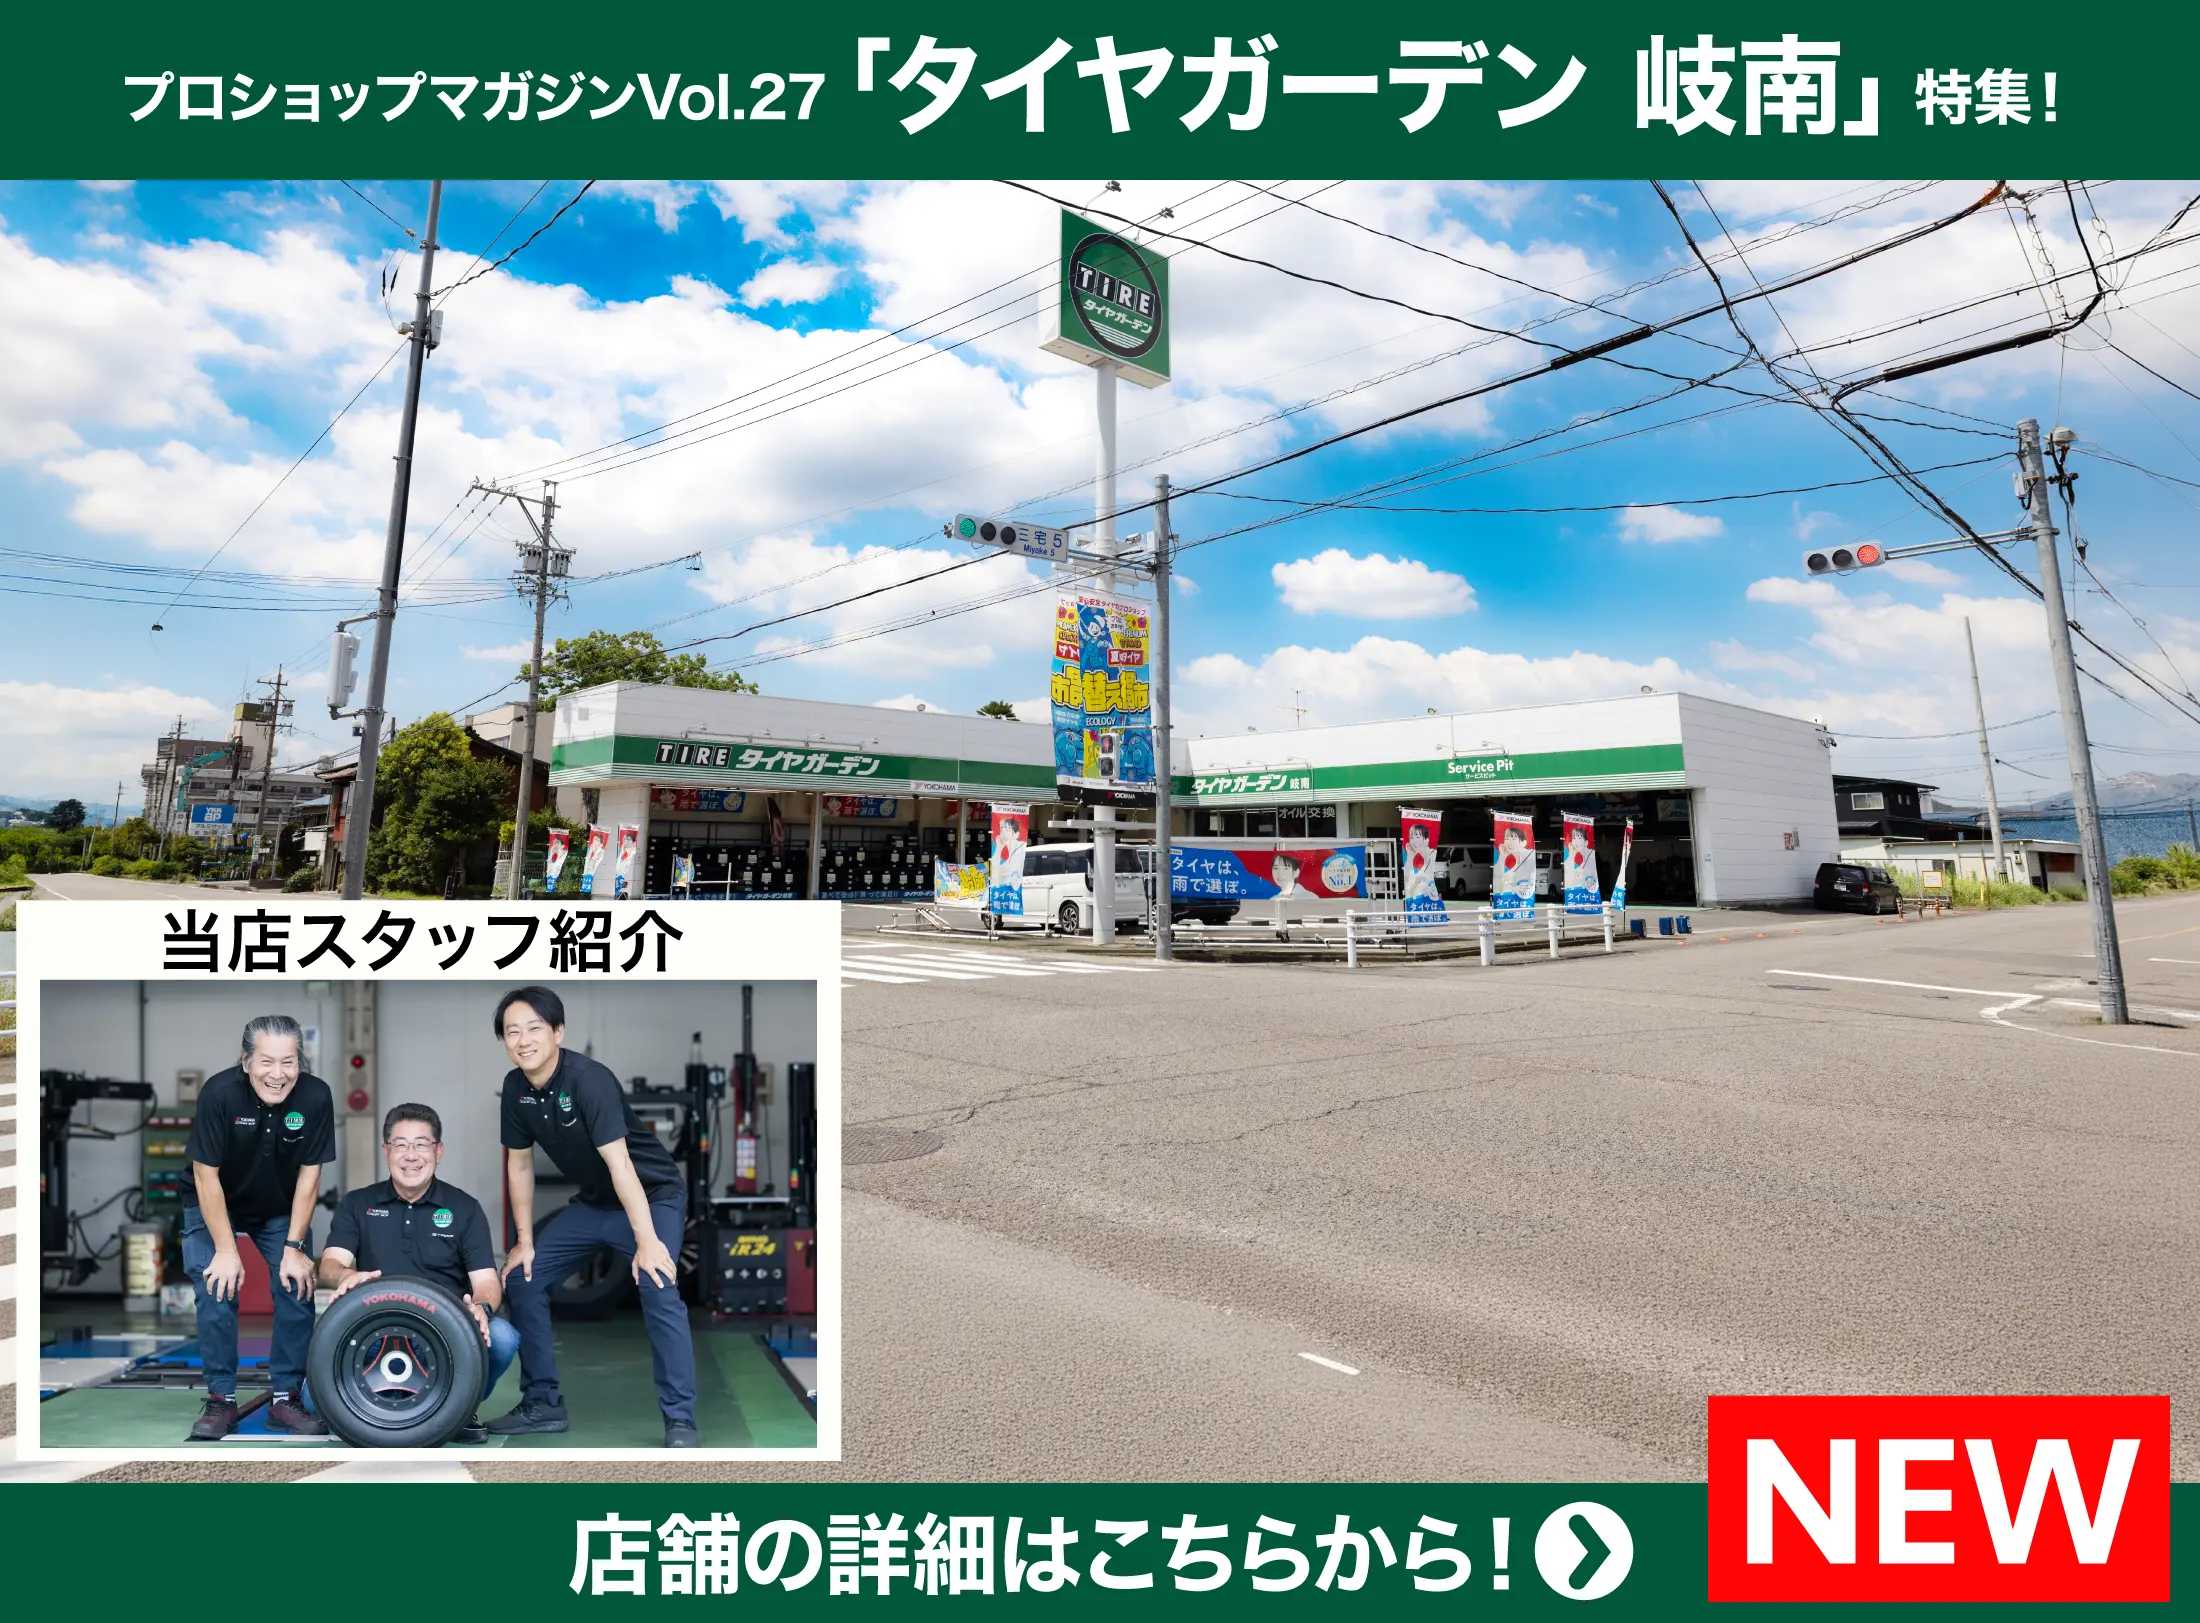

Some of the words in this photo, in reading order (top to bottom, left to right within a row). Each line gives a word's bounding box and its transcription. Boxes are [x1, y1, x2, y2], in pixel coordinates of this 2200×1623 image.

[1079, 266, 1151, 315] TIRE
[1083, 299, 1152, 334] タイヤガーデン
[1018, 527, 1047, 546] 三宅
[1053, 533, 1062, 548] 5
[1023, 543, 1048, 556] Miyake
[1086, 716, 1116, 726] ECOLOGY
[660, 743, 729, 766] TIRE
[736, 748, 880, 776] タイヤガーデン
[1447, 760, 1494, 775] Service
[1496, 759, 1514, 771] Pit
[923, 783, 956, 791] YOKOHAMA
[1190, 774, 1288, 795] タイヤガーデン
[1290, 777, 1310, 790] 岐南
[204, 813, 222, 822] ap
[1172, 856, 1239, 876] タイヤは、
[1172, 875, 1247, 895] 雨で選ぼ。
[362, 1293, 436, 1314] YOKOHAMA
